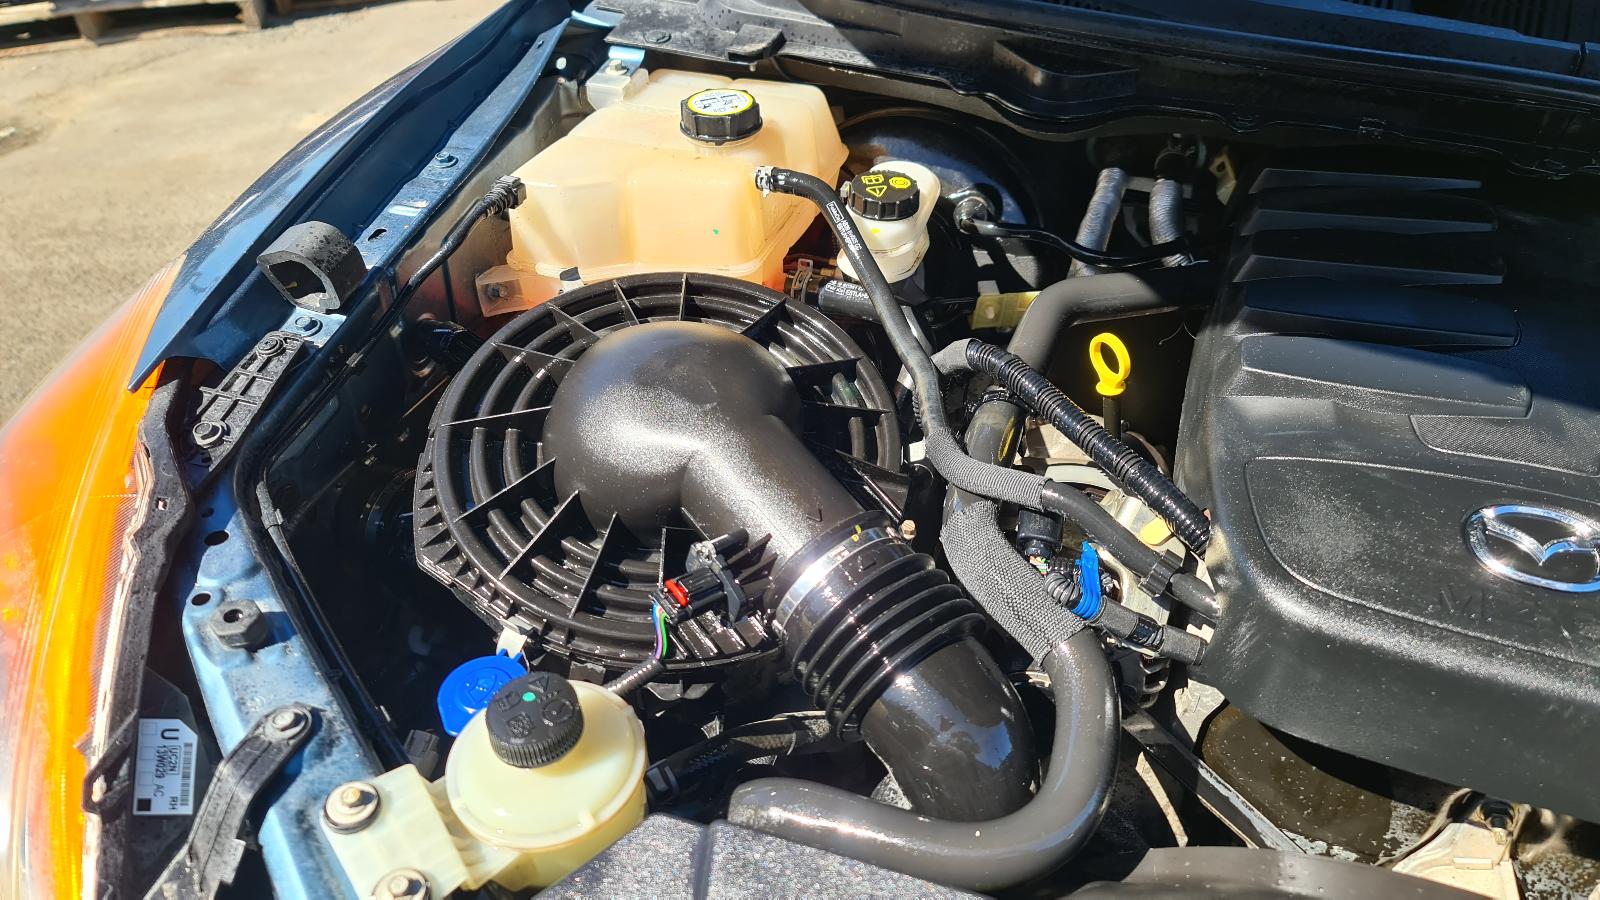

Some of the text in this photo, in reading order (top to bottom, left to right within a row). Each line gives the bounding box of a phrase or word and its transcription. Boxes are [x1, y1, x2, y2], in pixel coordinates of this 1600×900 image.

[160, 728, 180, 741] U
[153, 783, 165, 798] AC
[168, 796, 179, 811] RH
